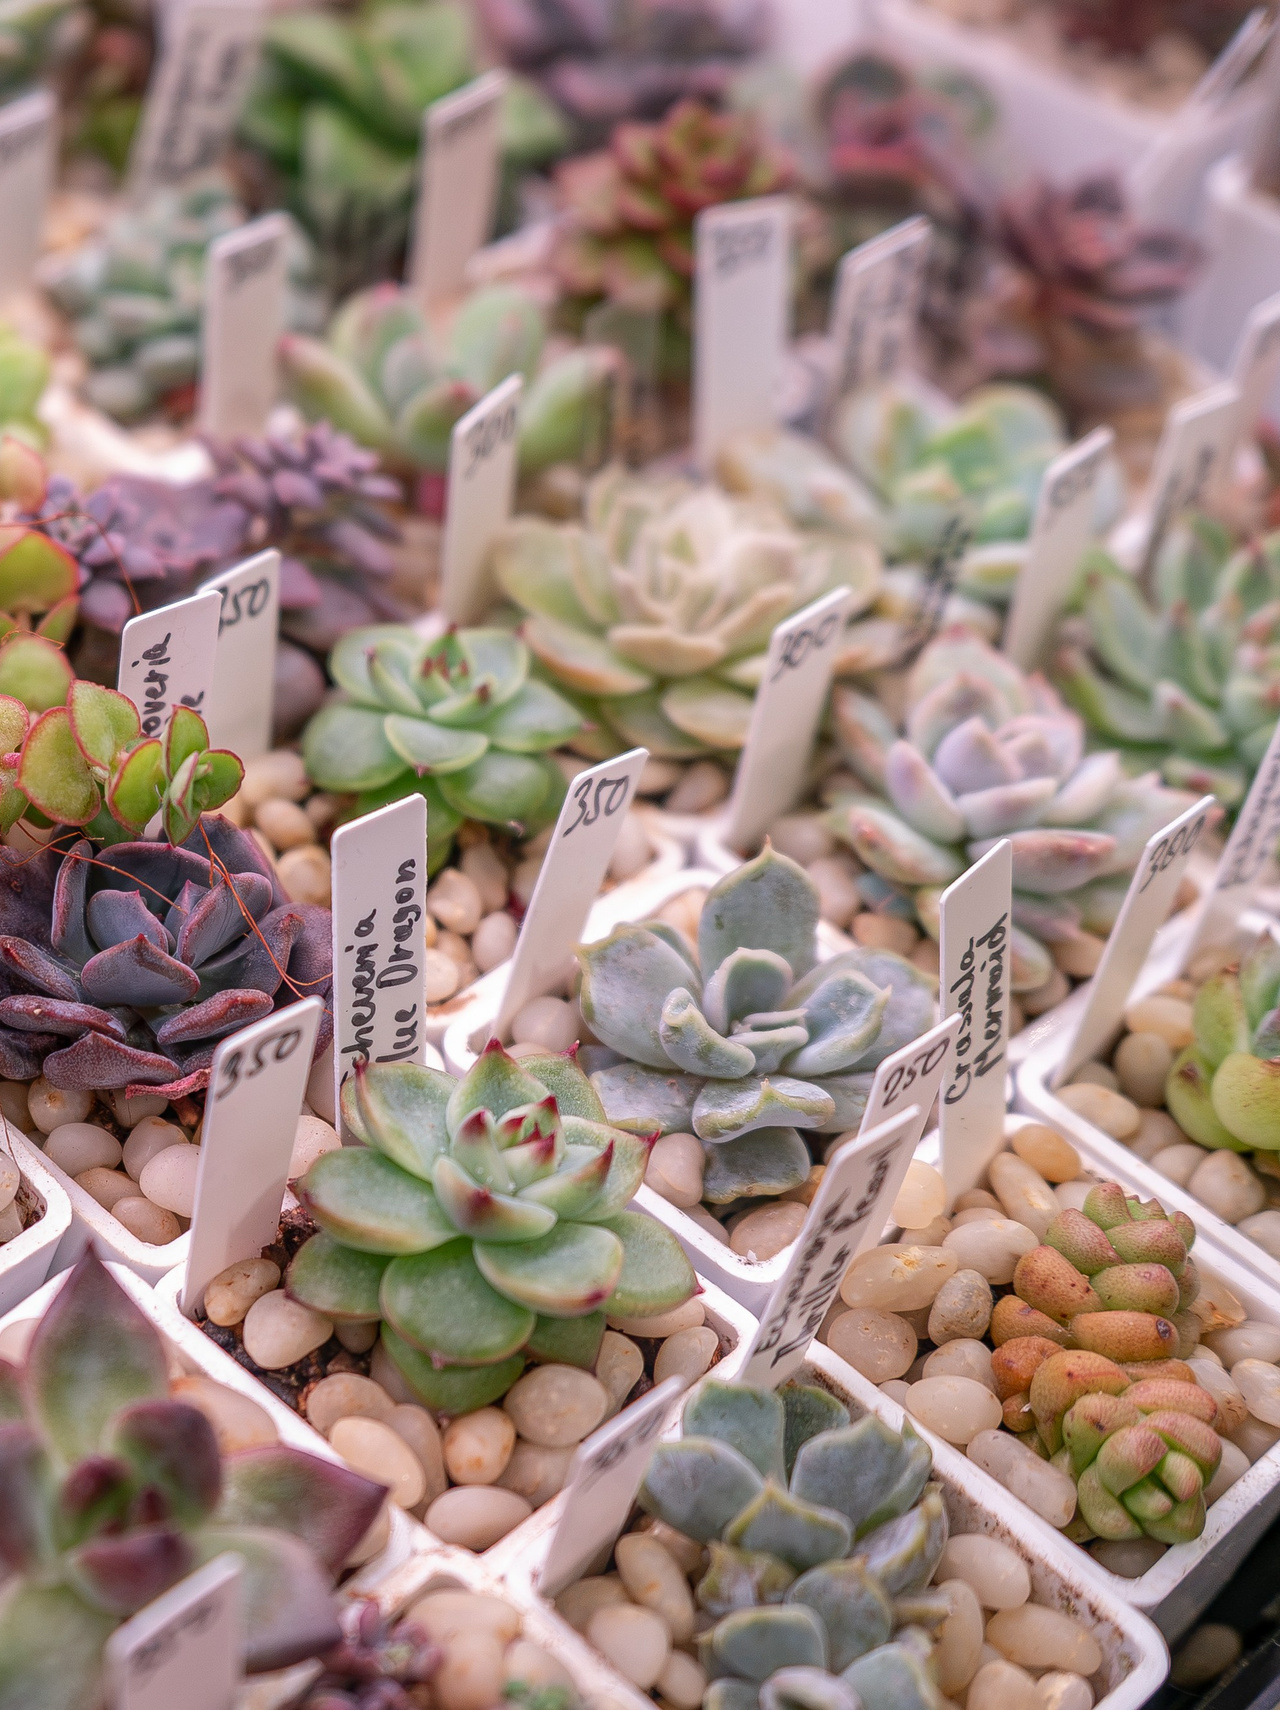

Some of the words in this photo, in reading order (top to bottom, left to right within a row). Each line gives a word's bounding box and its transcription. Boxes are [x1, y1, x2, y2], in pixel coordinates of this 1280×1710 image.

[131, 632, 171, 738] overia
[769, 612, 839, 682] 300
[563, 774, 630, 837] 350
[1138, 813, 1206, 894] 300
[376, 858, 422, 989] Dragon
[340, 908, 379, 1087] cheveria
[375, 1003, 419, 1064] lue
[974, 912, 1009, 1078] Mermaid
[216, 1026, 302, 1101] 350
[882, 1037, 950, 1108] 250
